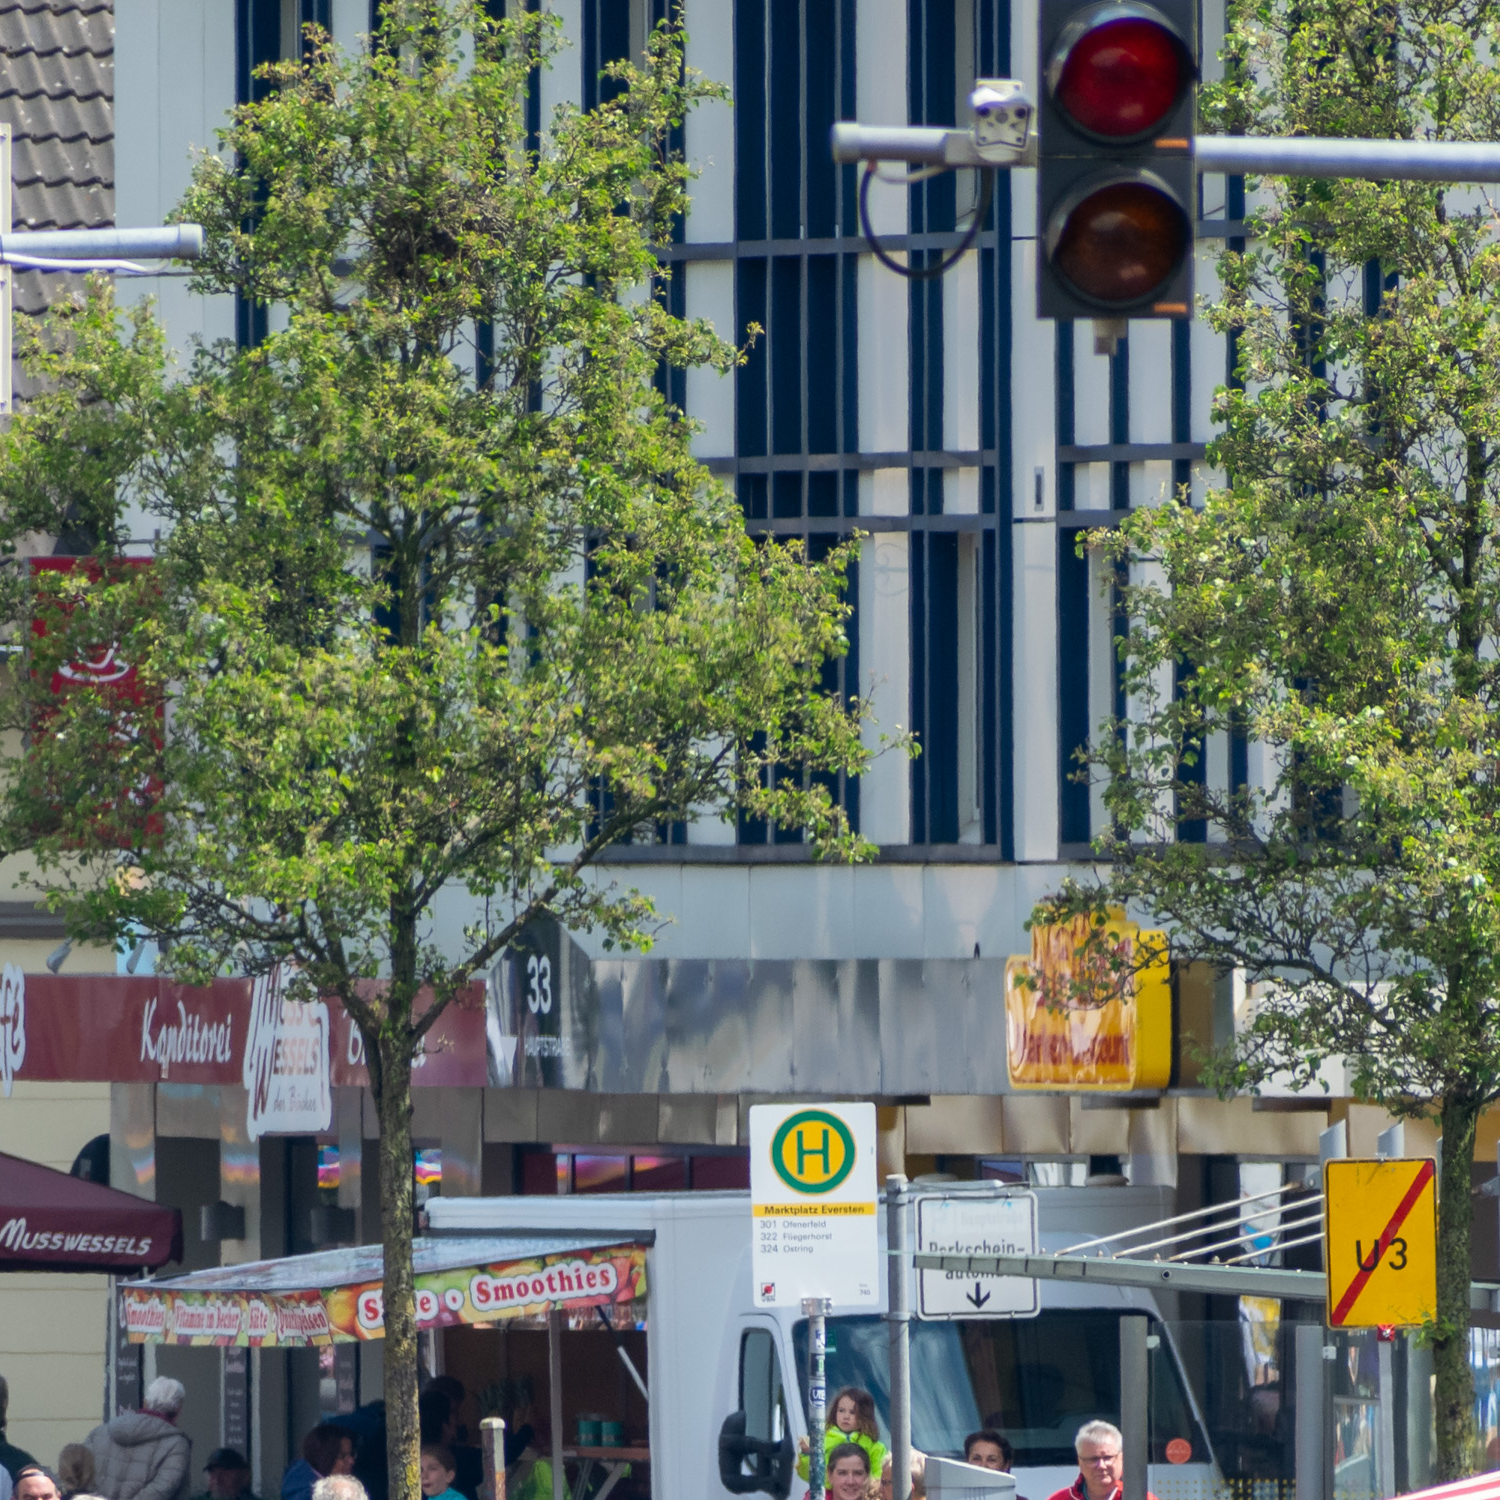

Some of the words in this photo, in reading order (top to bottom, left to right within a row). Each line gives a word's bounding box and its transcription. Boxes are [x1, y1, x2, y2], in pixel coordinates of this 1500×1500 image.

[526, 953, 552, 1014] 33
[796, 1128, 830, 1176] H
[764, 1206, 818, 1216] Marktplatz
[821, 1206, 865, 1215] Eversten
[760, 1220, 777, 1229] 301
[782, 1220, 827, 1229] Ofenerfeld
[760, 1232, 778, 1241] 322
[782, 1232, 833, 1242] Fliegerhorst
[760, 1245, 778, 1253] 324
[783, 1244, 814, 1254] Ostring
[476, 1265, 612, 1303] Smoothies
